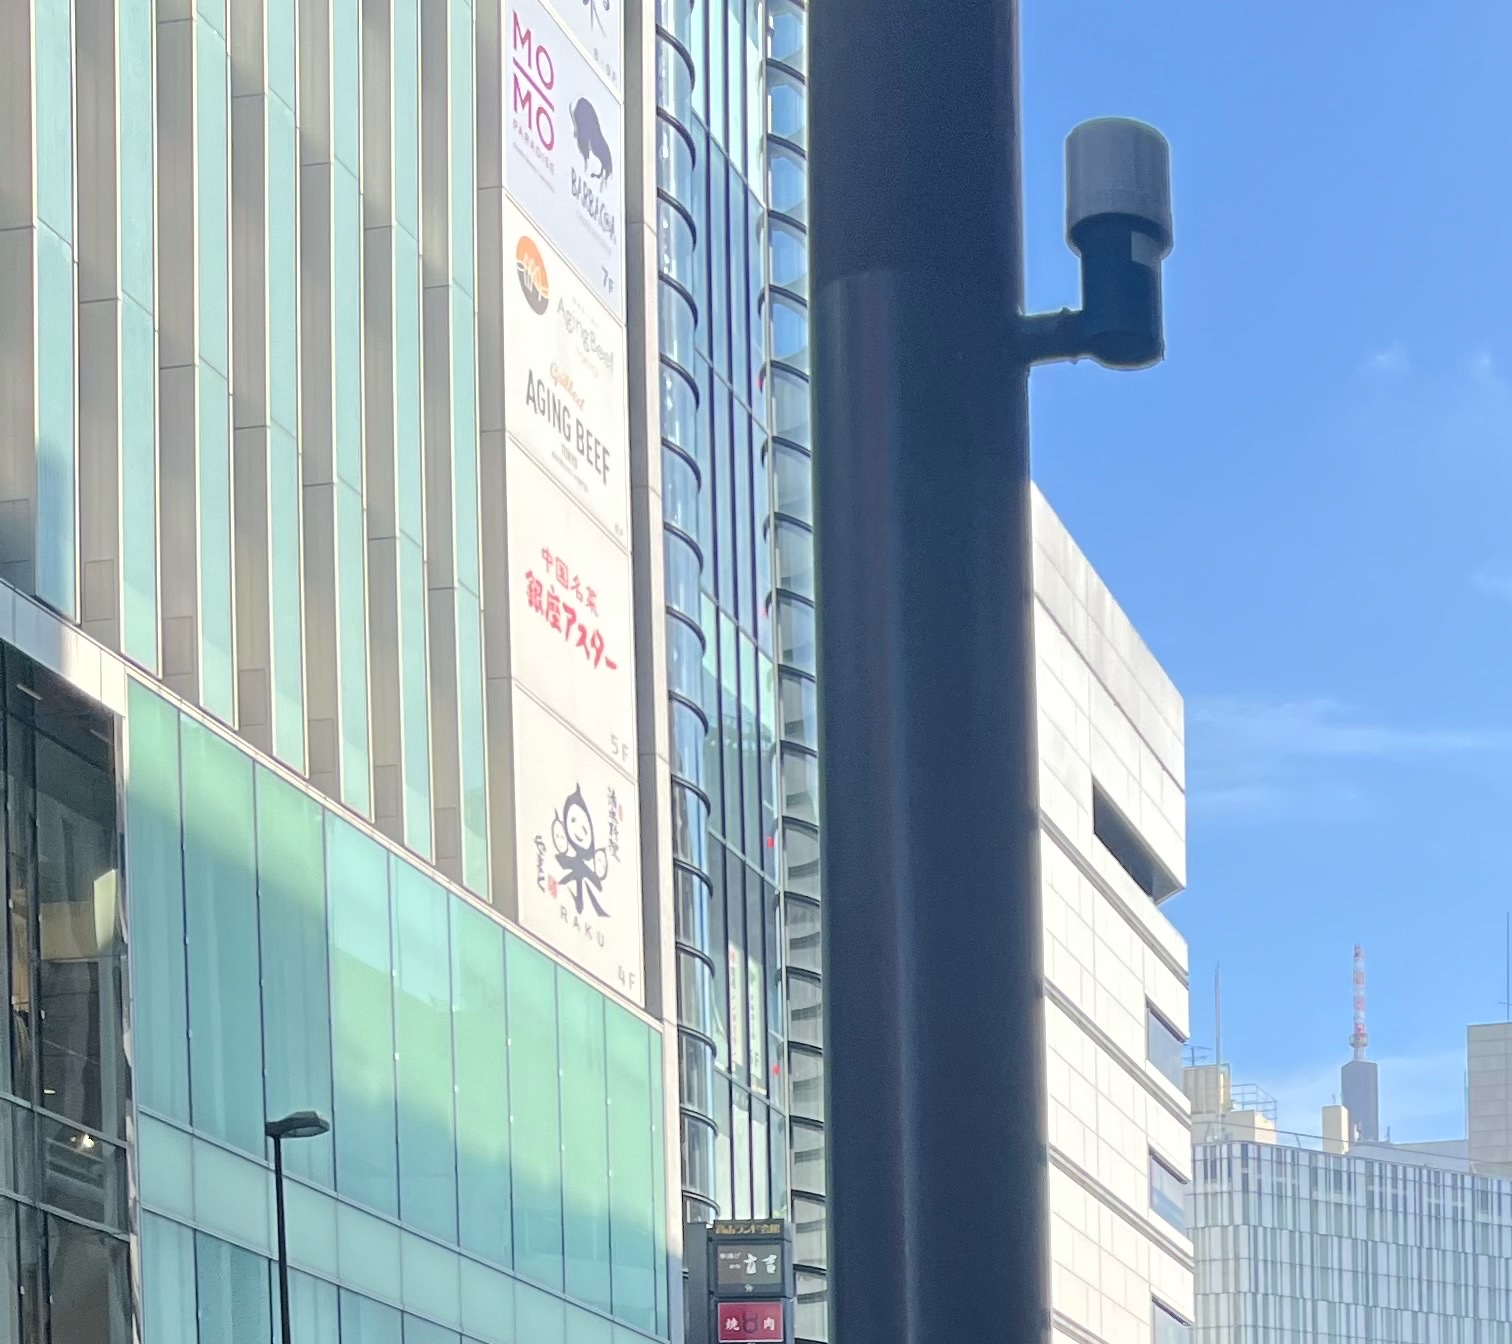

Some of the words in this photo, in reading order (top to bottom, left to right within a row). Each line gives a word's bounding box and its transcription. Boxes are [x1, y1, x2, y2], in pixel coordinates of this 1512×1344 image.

[512, 9, 554, 90] MO
[512, 71, 554, 151] MO
[526, 368, 571, 442] AGING
[576, 417, 611, 486] BEEF
[525, 569, 618, 670] 銀座アスター
[611, 734, 629, 762] 5F
[560, 905, 605, 948] RAKU
[618, 965, 636, 990] 4F
